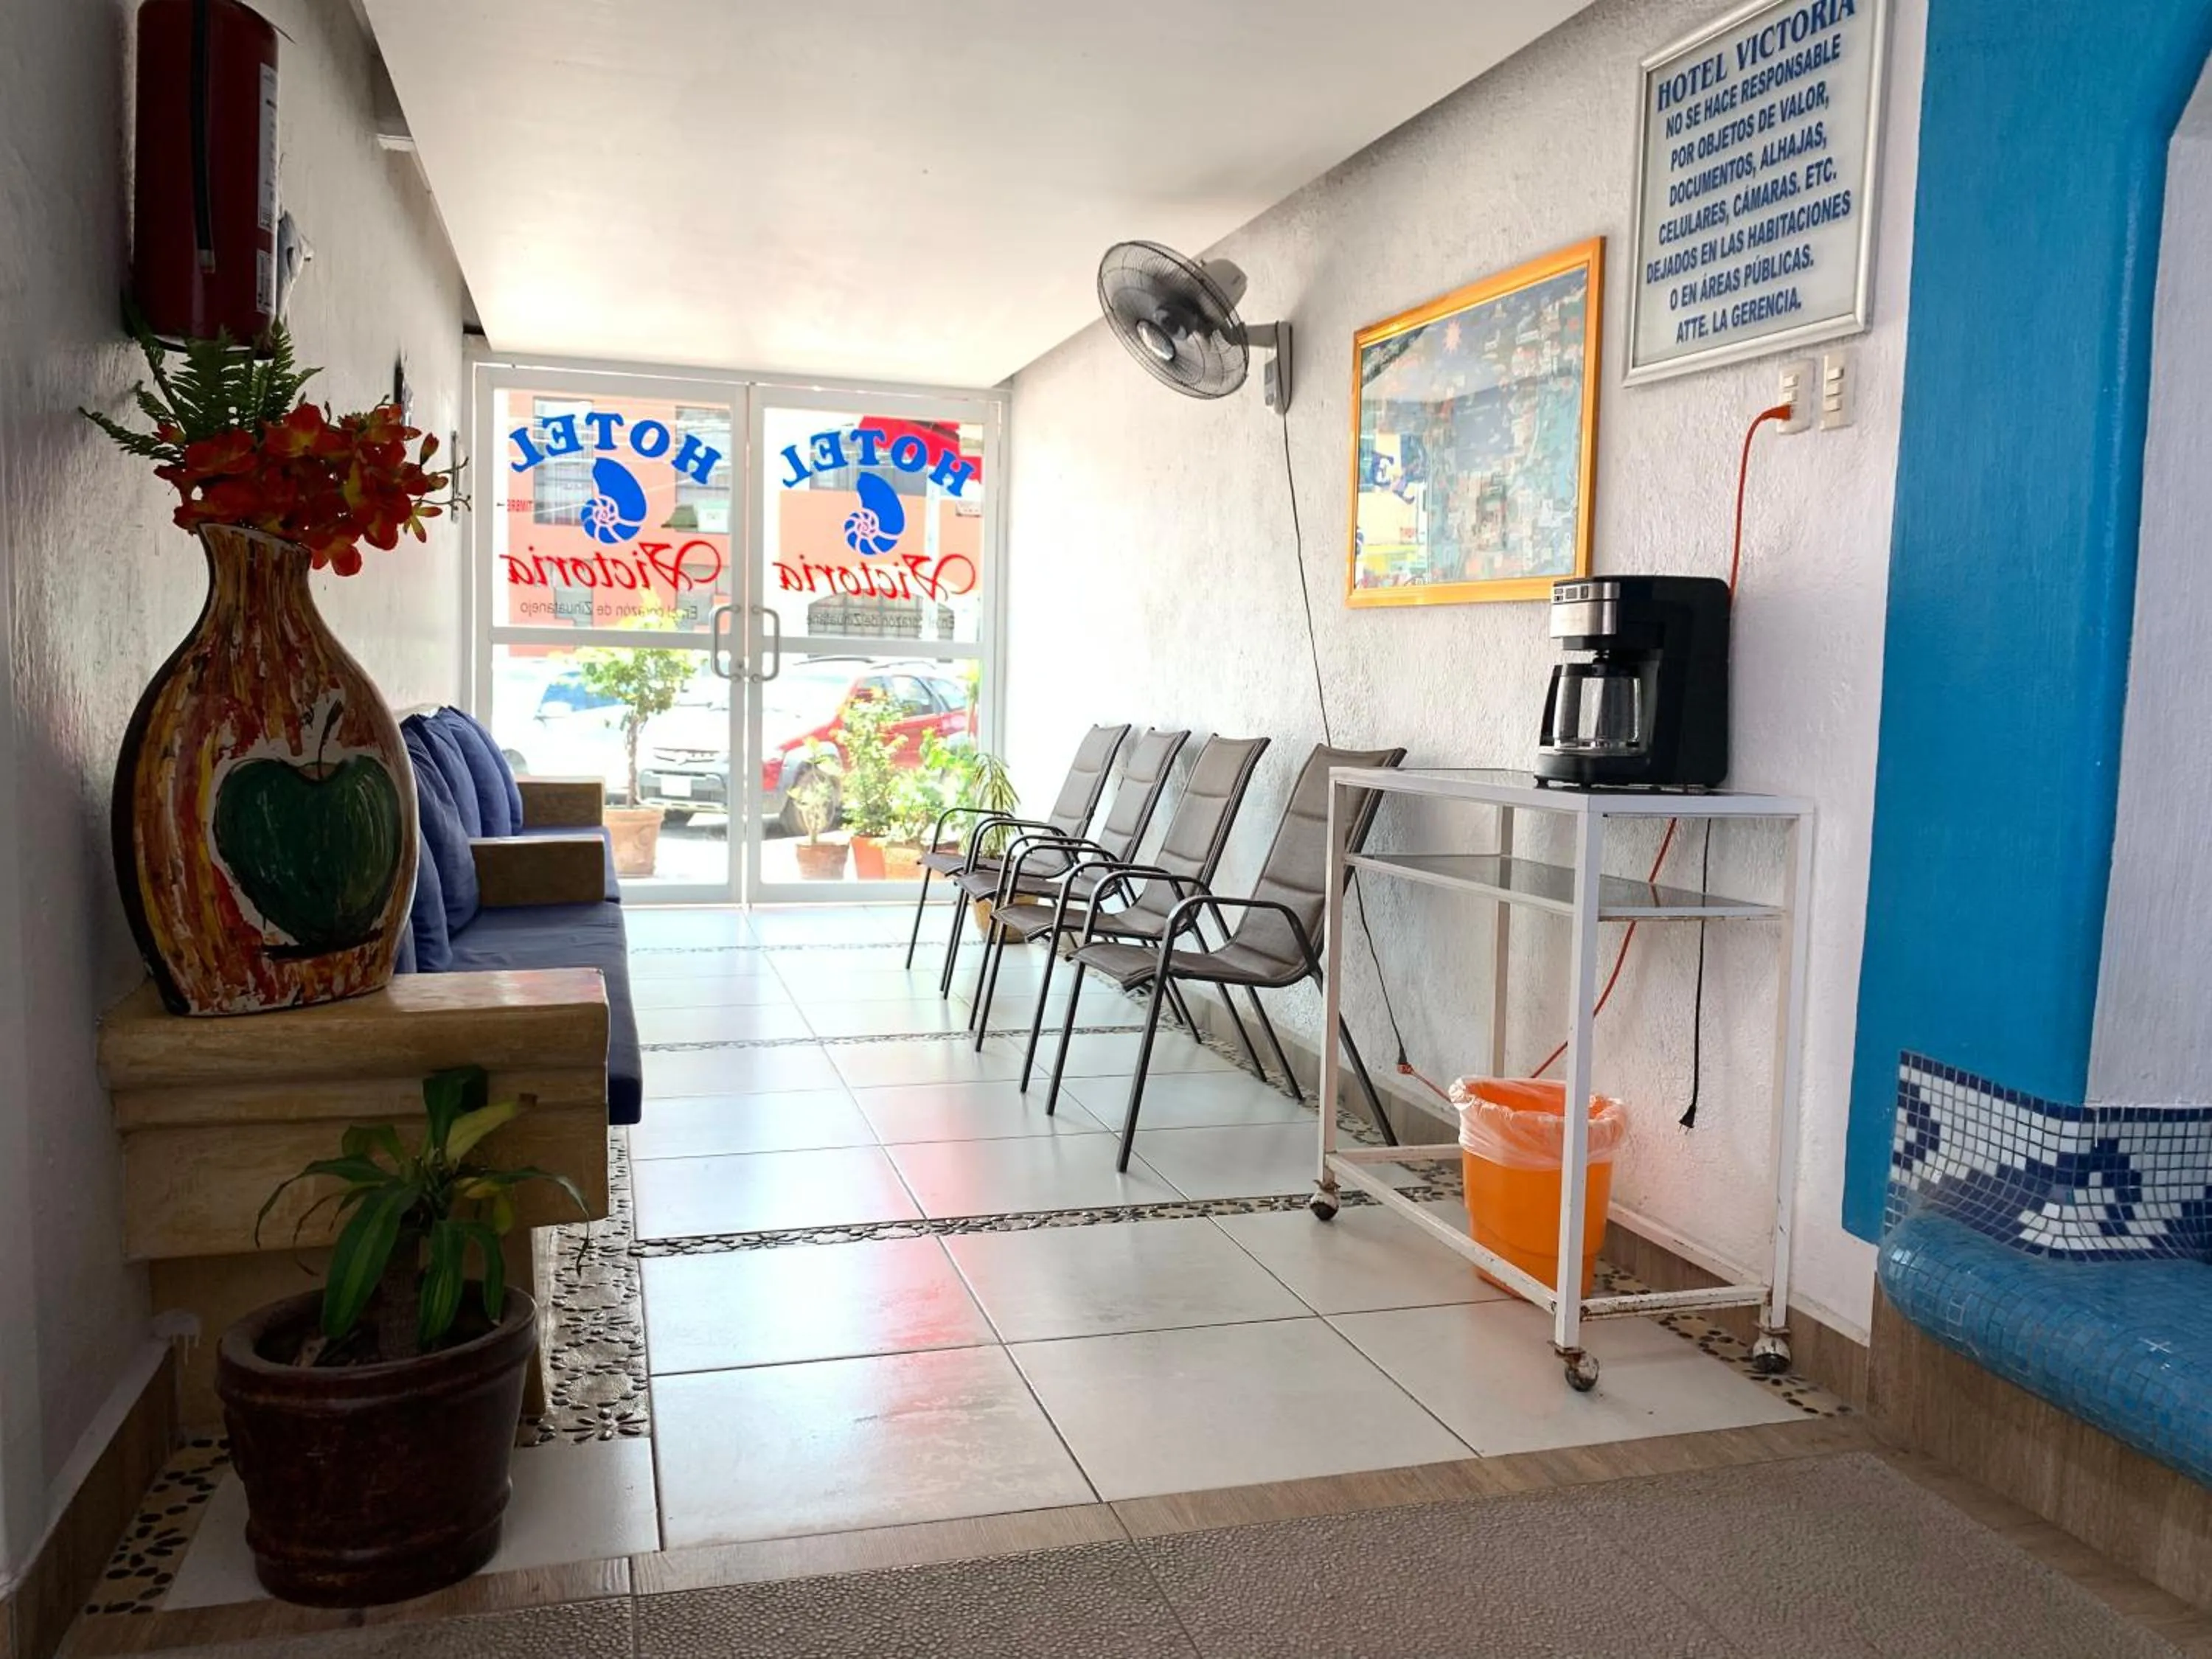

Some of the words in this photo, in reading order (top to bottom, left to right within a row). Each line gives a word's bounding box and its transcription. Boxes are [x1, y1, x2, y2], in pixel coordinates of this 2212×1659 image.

[1658, 53, 1727, 113] HOTEL
[1736, 0, 1855, 71] VICTORIA
[1666, 113, 1682, 139] NO
[1686, 102, 1701, 130] SE
[1704, 85, 1737, 121] HACE
[1741, 34, 1841, 104] RESPONSABLE
[1669, 152, 1756, 206] DOCUMENTOS,
[1760, 122, 1827, 170] ALHAJAS,
[1671, 142, 1694, 171] POR
[1697, 114, 1754, 159] OBJETOS
[1758, 104, 1775, 133] DE
[1779, 81, 1829, 122] VALOR,
[1646, 247, 1697, 284] DEJADOS
[1701, 240, 1717, 265] EN
[1720, 229, 1744, 258] LAS
[1747, 189, 1851, 249] HABITACIONES
[1659, 200, 1729, 245] CELULARES,
[1733, 172, 1801, 217] CÁMARAS.
[1806, 157, 1837, 190] ETC.
[1670, 288, 1678, 310] O
[1681, 282, 1696, 307] EN
[1700, 268, 1741, 301] ÁREAS
[1744, 244, 1814, 288] PÚBLICAS.
[1676, 315, 1708, 344] ATTE.
[1713, 309, 1728, 334] LA
[1732, 287, 1801, 328] GERENCIA.
